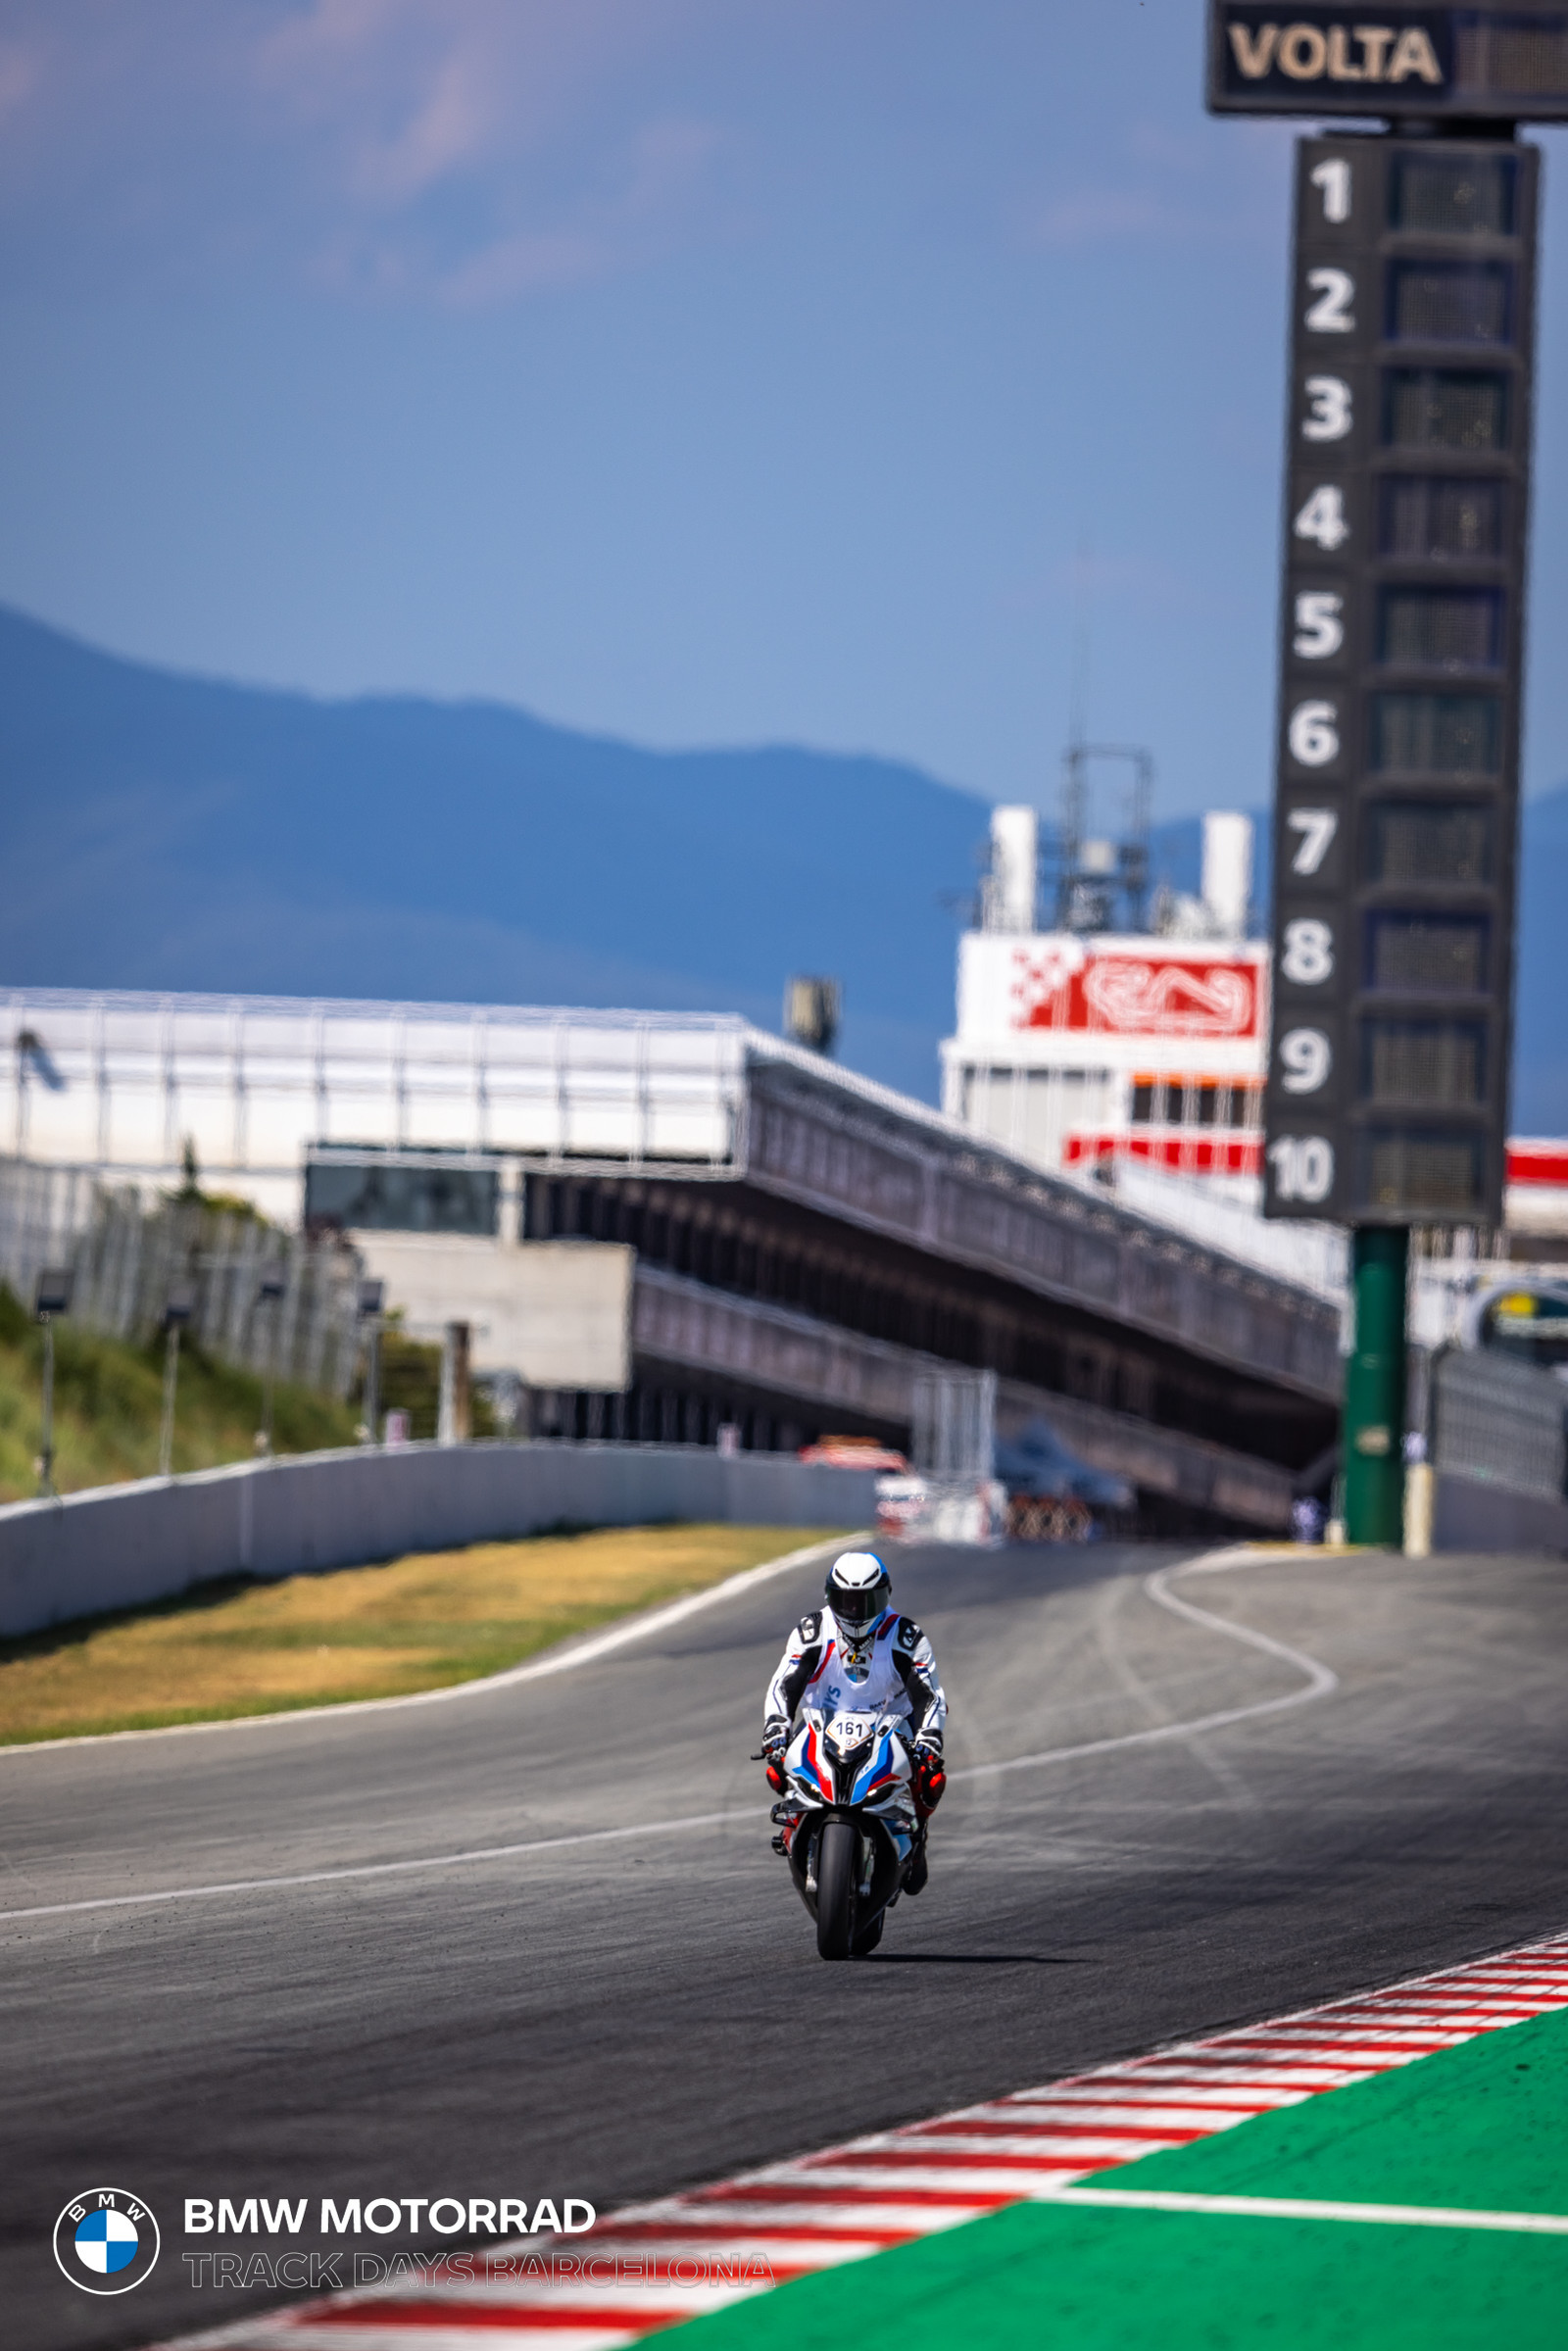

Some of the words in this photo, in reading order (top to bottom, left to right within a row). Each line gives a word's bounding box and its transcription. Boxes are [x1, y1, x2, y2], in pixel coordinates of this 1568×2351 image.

[1228, 23, 1443, 83] VOLTA
[1310, 158, 1351, 223] 1
[1304, 268, 1355, 333] 2
[1301, 375, 1352, 442] 3
[1294, 484, 1349, 551] 4
[1293, 591, 1344, 660] 5
[1288, 700, 1340, 767] 6
[1287, 808, 1338, 875] 7
[1280, 917, 1334, 985] 8
[1279, 1027, 1332, 1095] 9
[1268, 1135, 1334, 1203] 10
[836, 1721, 863, 1738] 161
